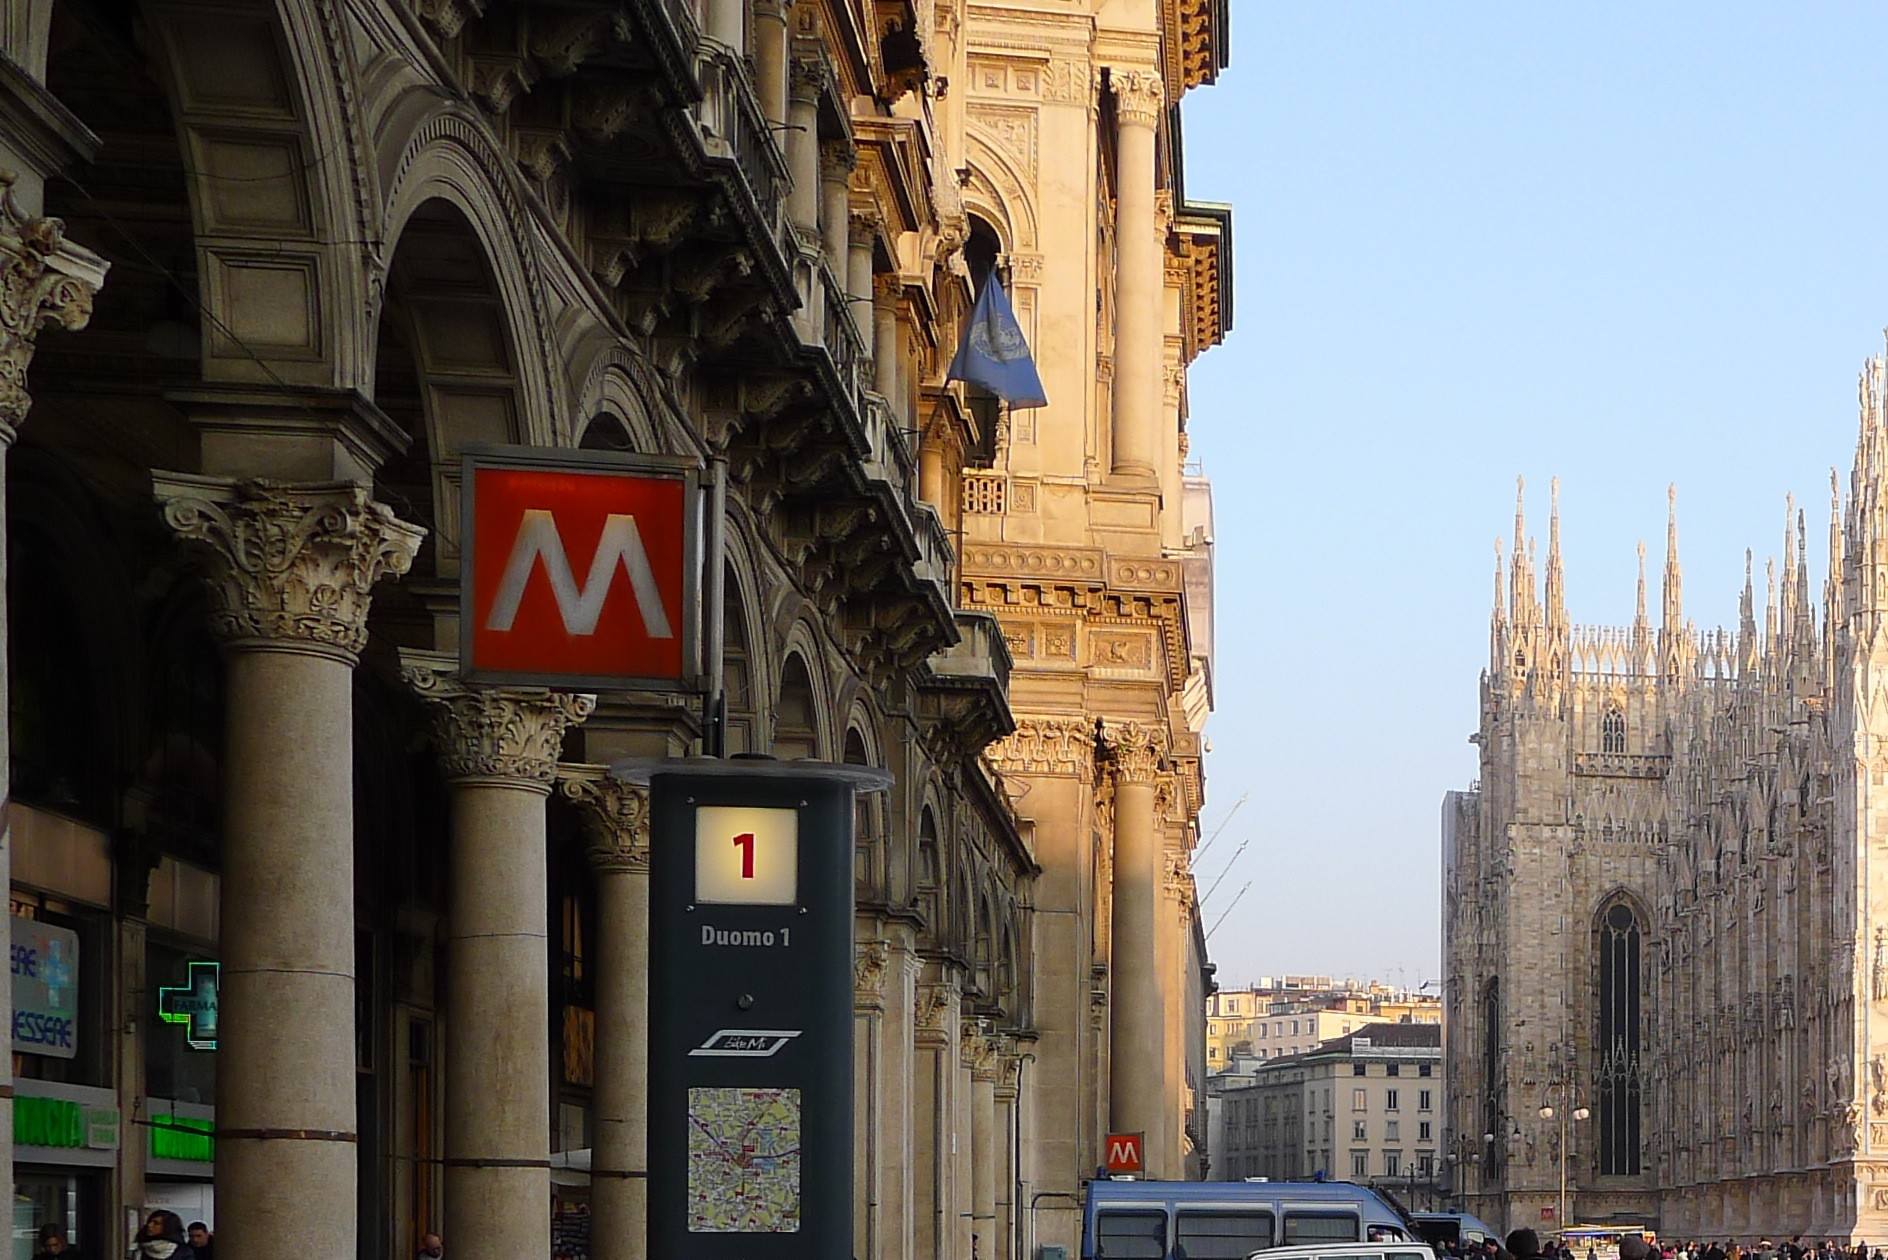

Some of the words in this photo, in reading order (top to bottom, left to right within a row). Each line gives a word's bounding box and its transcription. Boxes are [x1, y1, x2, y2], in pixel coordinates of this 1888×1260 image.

[485, 508, 674, 639] M
[732, 833, 755, 879] 1
[701, 925, 775, 947] Duomo
[780, 928, 790, 947] 1
[174, 1000, 217, 1012] FARMA
[1109, 1141, 1139, 1164] M
